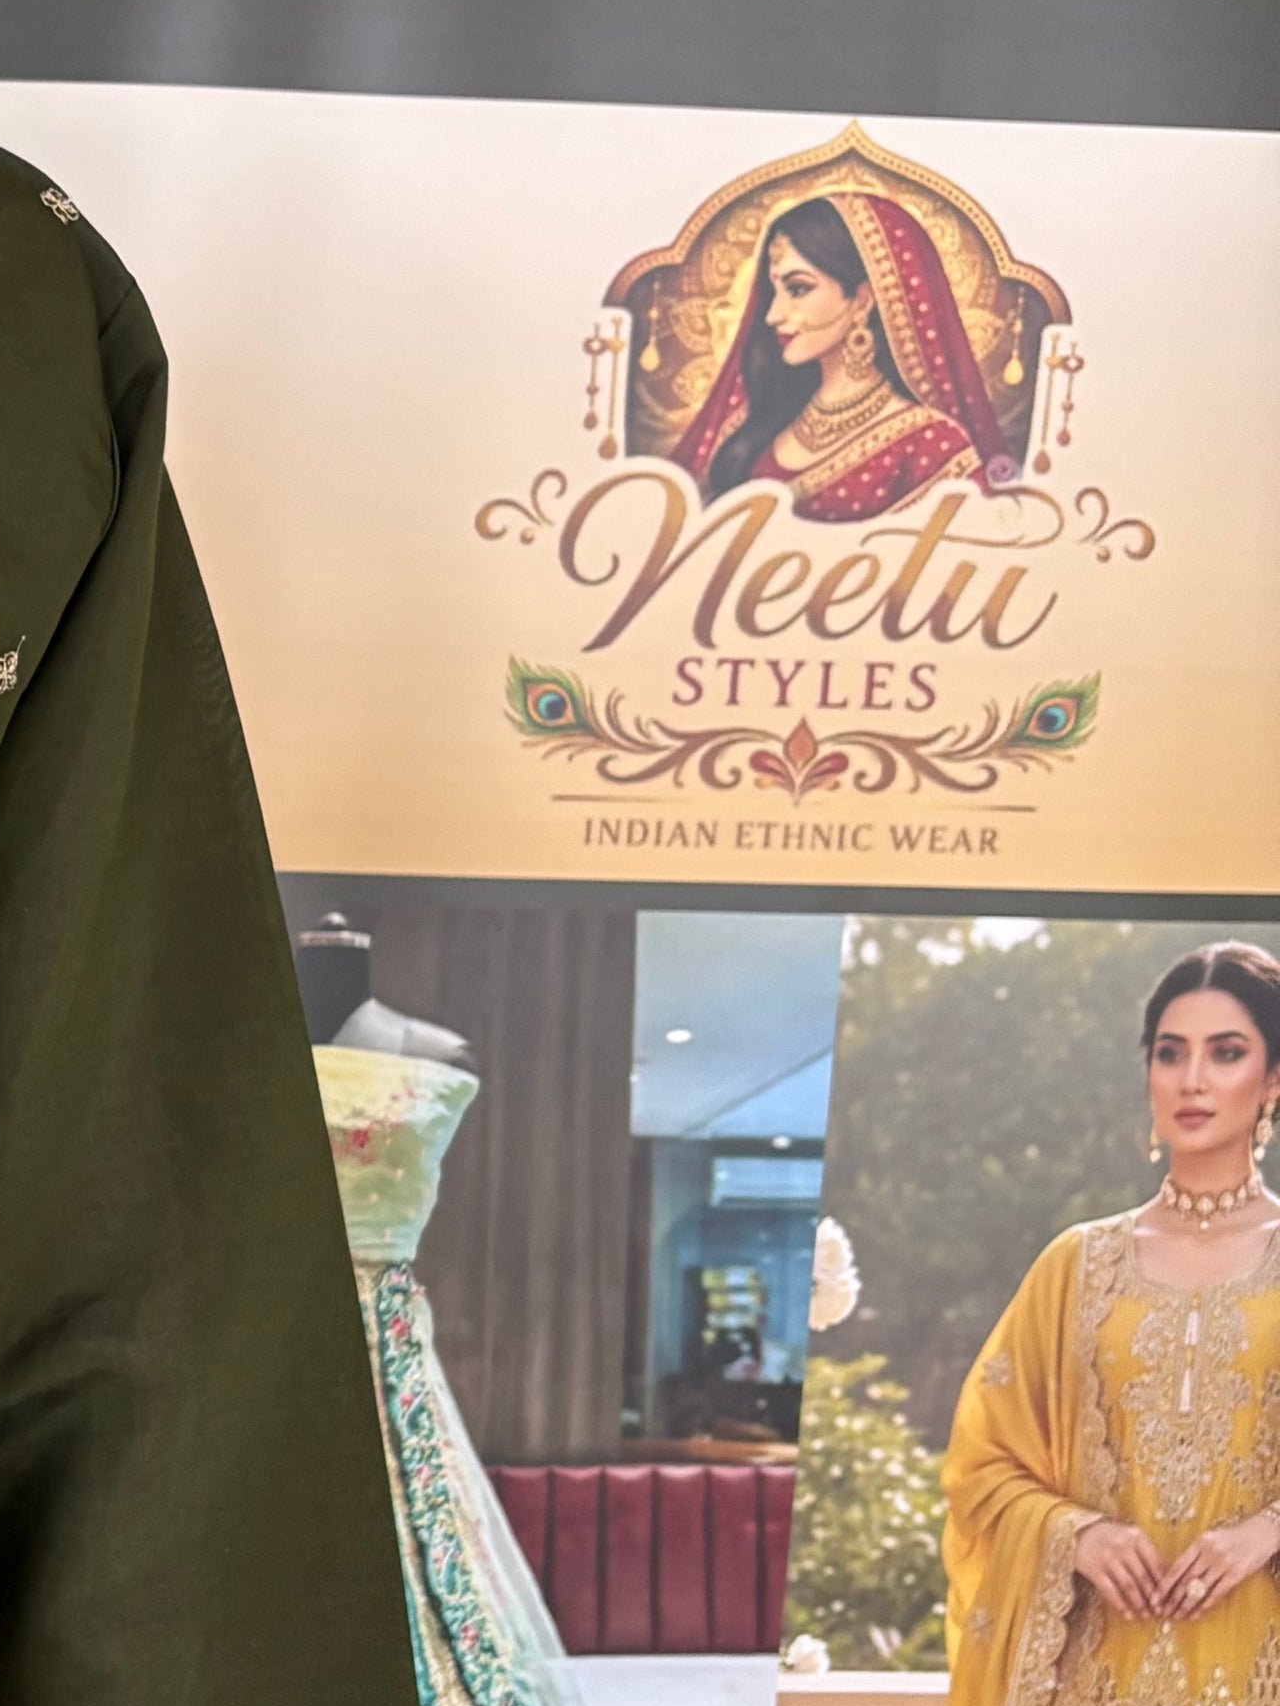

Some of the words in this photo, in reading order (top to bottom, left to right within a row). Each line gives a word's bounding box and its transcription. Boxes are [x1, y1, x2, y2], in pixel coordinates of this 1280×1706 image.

[559, 471, 1064, 652] Neetu
[671, 654, 938, 711] STYLES
[582, 817, 719, 849] INDIAN
[734, 820, 874, 853] ETHNIC
[888, 824, 1000, 856] WEAR
